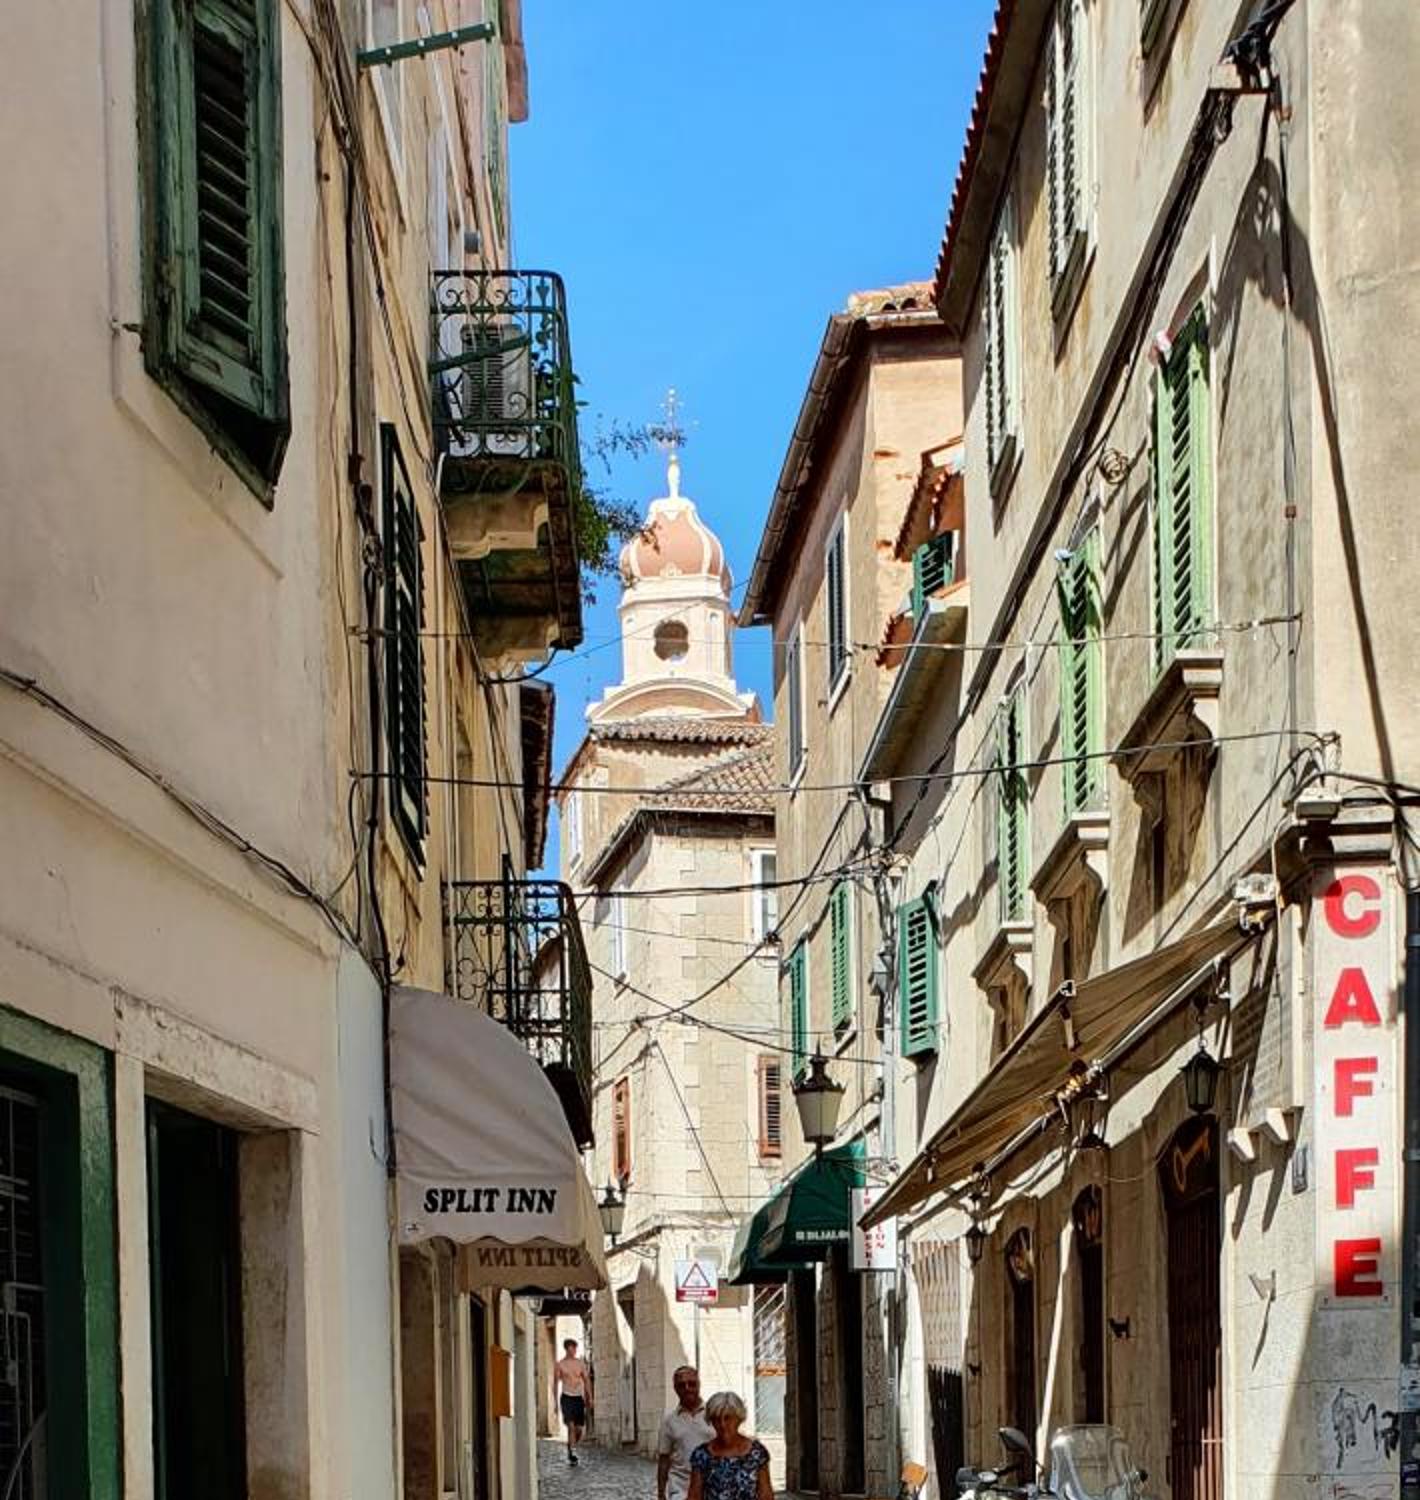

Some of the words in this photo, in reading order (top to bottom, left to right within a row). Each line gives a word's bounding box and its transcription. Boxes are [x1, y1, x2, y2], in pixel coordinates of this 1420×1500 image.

[1322, 875, 1383, 1298] CAFFE
[424, 1188, 501, 1213] SPLIT
[505, 1188, 558, 1214] INN
